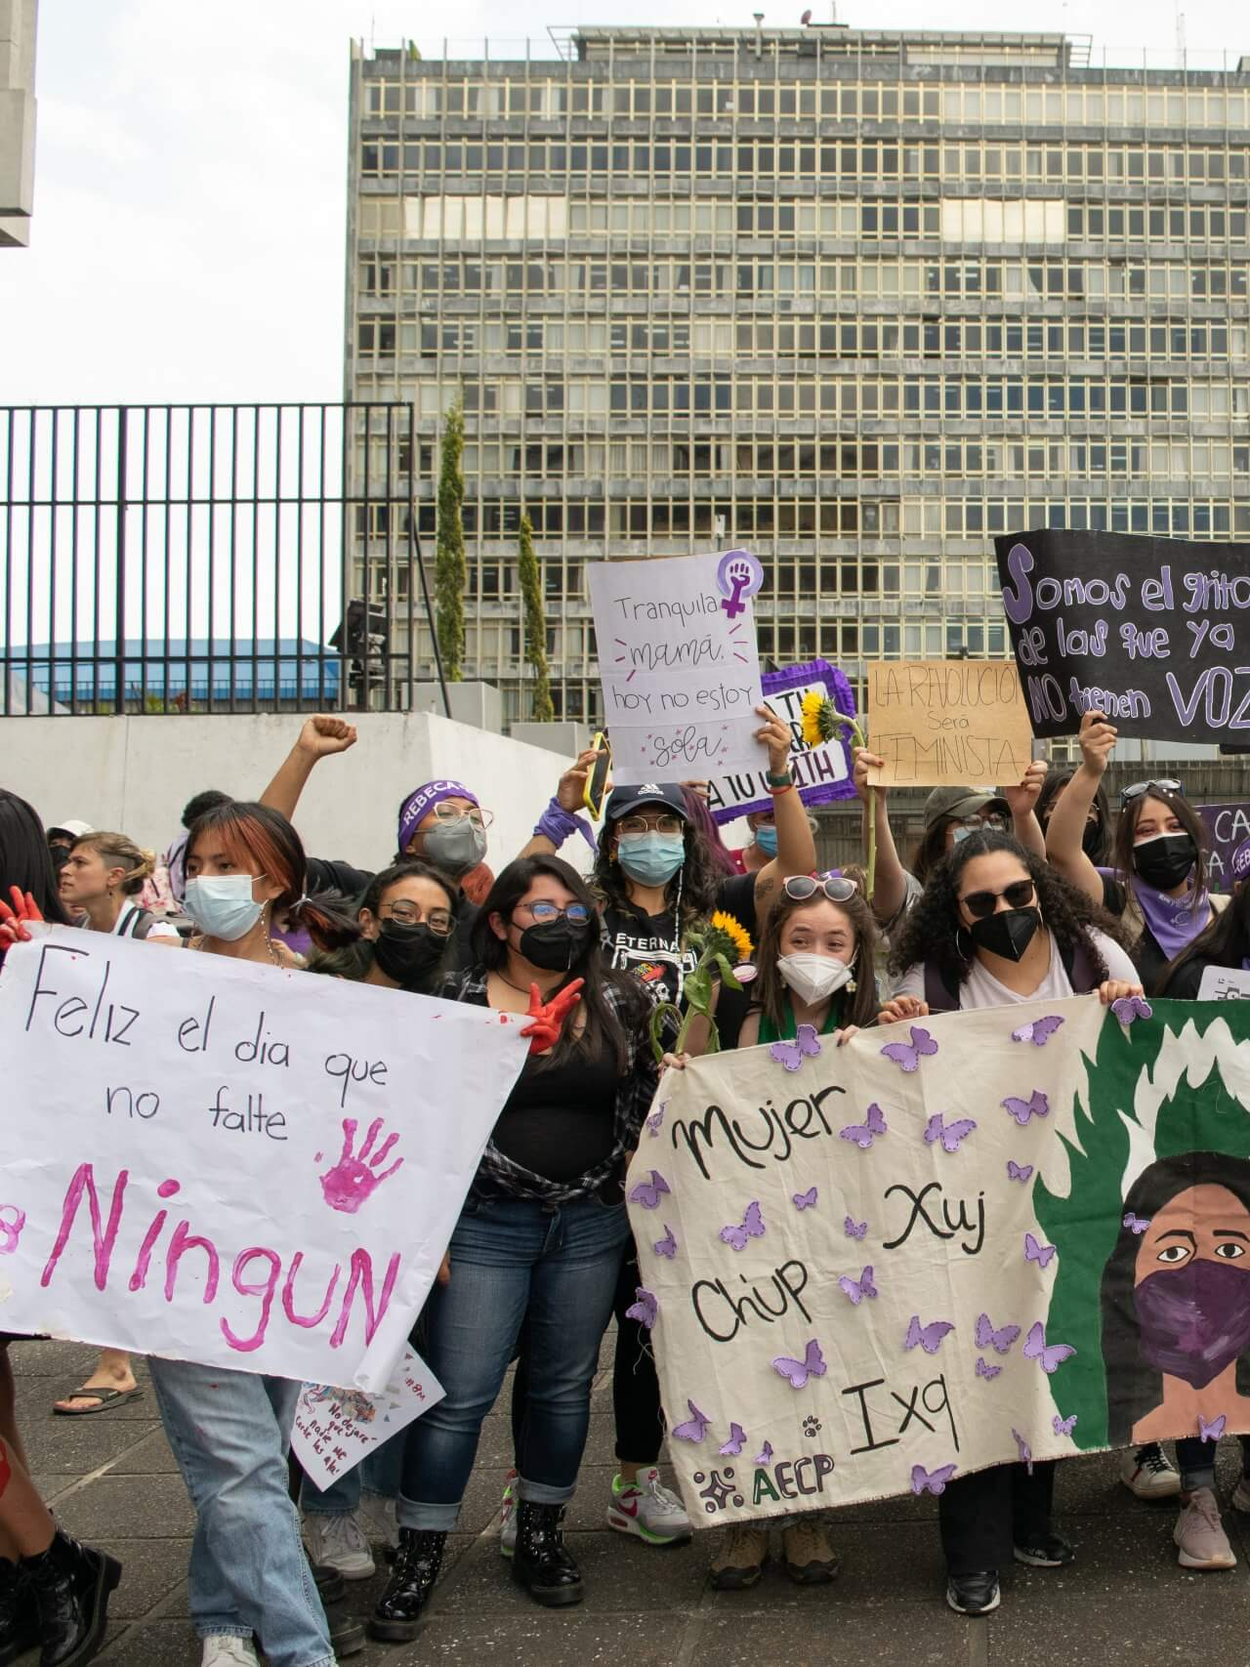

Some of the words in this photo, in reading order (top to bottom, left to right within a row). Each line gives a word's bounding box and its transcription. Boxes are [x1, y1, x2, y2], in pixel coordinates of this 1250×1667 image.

[1002, 543, 1132, 625] Somos
[1141, 565, 1175, 611] el
[614, 592, 718, 628] Tranquila
[1018, 626, 1048, 666] de
[1056, 617, 1109, 657] las
[1120, 622, 1171, 660] que
[662, 690, 689, 708] no
[875, 669, 905, 707] LA
[906, 664, 1019, 708] REVOLUCIÓ
[1027, 673, 1067, 723] NO
[1069, 677, 1151, 719] tienen
[654, 726, 722, 767] sola
[873, 732, 1025, 781] FEMINISTA
[403, 780, 459, 826] REBECA
[26, 944, 140, 1046] Feliz
[178, 996, 215, 1052] el
[325, 1052, 390, 1108] que
[107, 1086, 160, 1118] no
[209, 1085, 288, 1140] falte
[671, 1085, 846, 1180] Mujer
[883, 1181, 986, 1255] Xuj
[309, 1419, 332, 1444] nadie
[327, 1420, 344, 1435] que
[328, 1402, 341, 1419] No
[842, 1373, 960, 1456] Ixq
[753, 1454, 835, 1505] AECP
